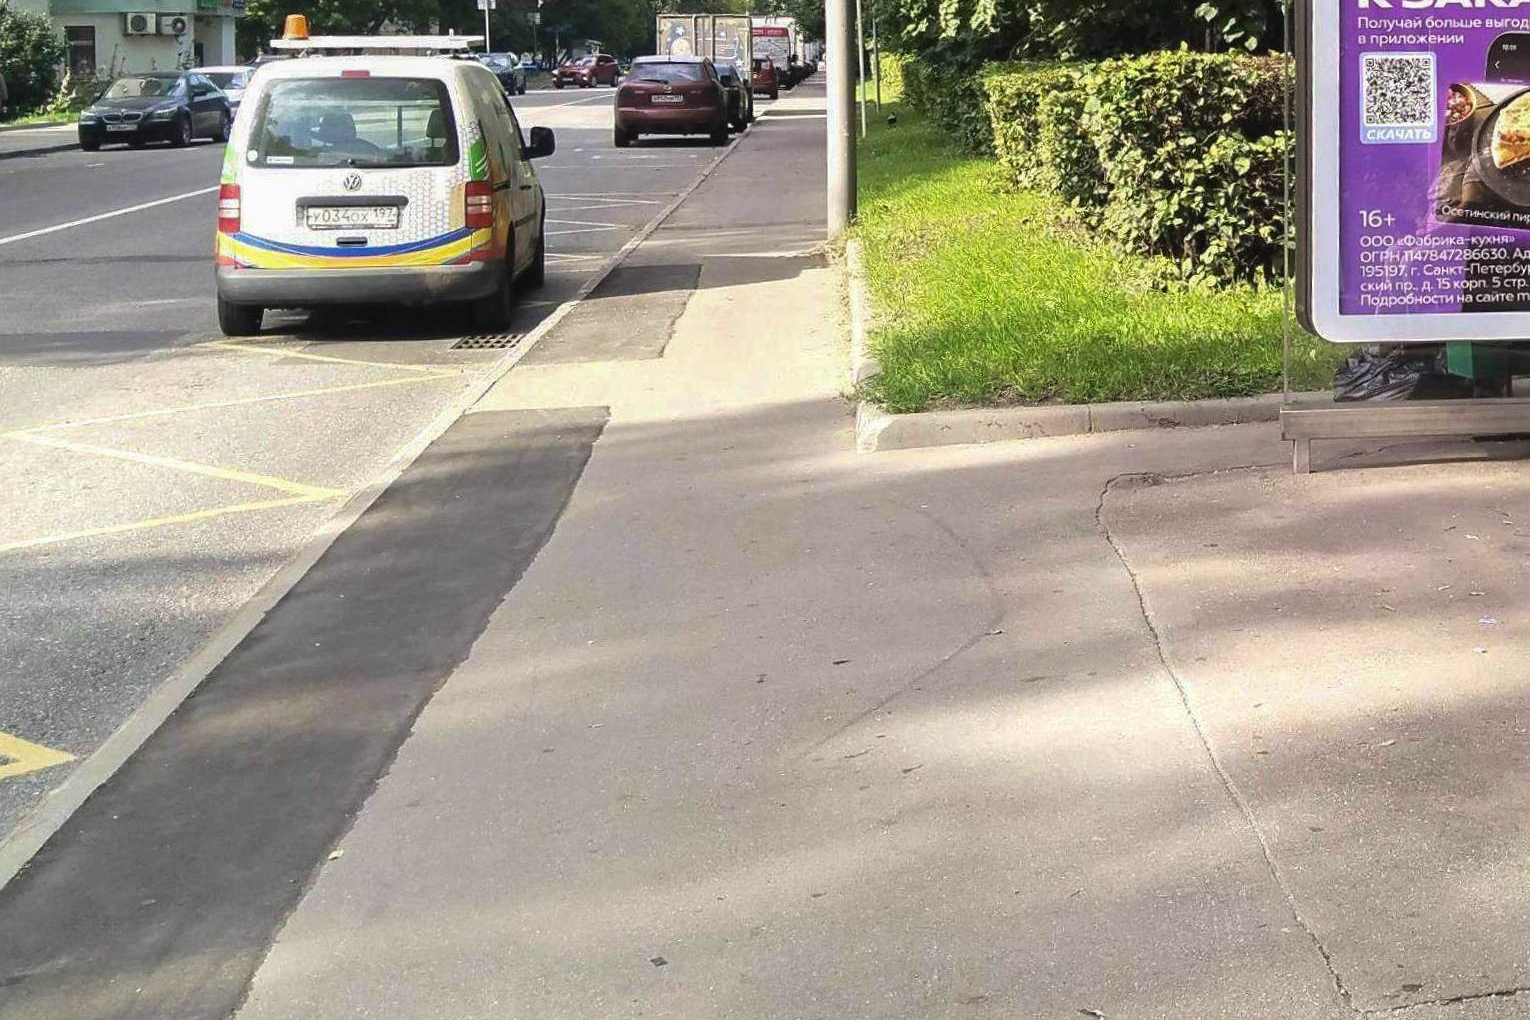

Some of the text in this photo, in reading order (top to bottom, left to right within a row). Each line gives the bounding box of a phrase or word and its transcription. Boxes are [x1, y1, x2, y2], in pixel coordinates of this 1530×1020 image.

[1358, 16, 1423, 32] Получай
[1425, 16, 1483, 29] больше
[1357, 34, 1465, 48] в приложении
[1366, 129, 1432, 141] СКАЧАТЬ
[1359, 209, 1396, 228] 16+
[1441, 205, 1511, 221] Осетинский
[1360, 235, 1395, 247] ООО
[1360, 251, 1400, 263] ОГРН
[1360, 281, 1393, 292] ский
[1436, 277, 1451, 289] 15
[1491, 277, 1501, 288] 5
[1360, 293, 1455, 307] Подробности
[1456, 294, 1473, 303] на
[1475, 292, 1515, 303] сайте
